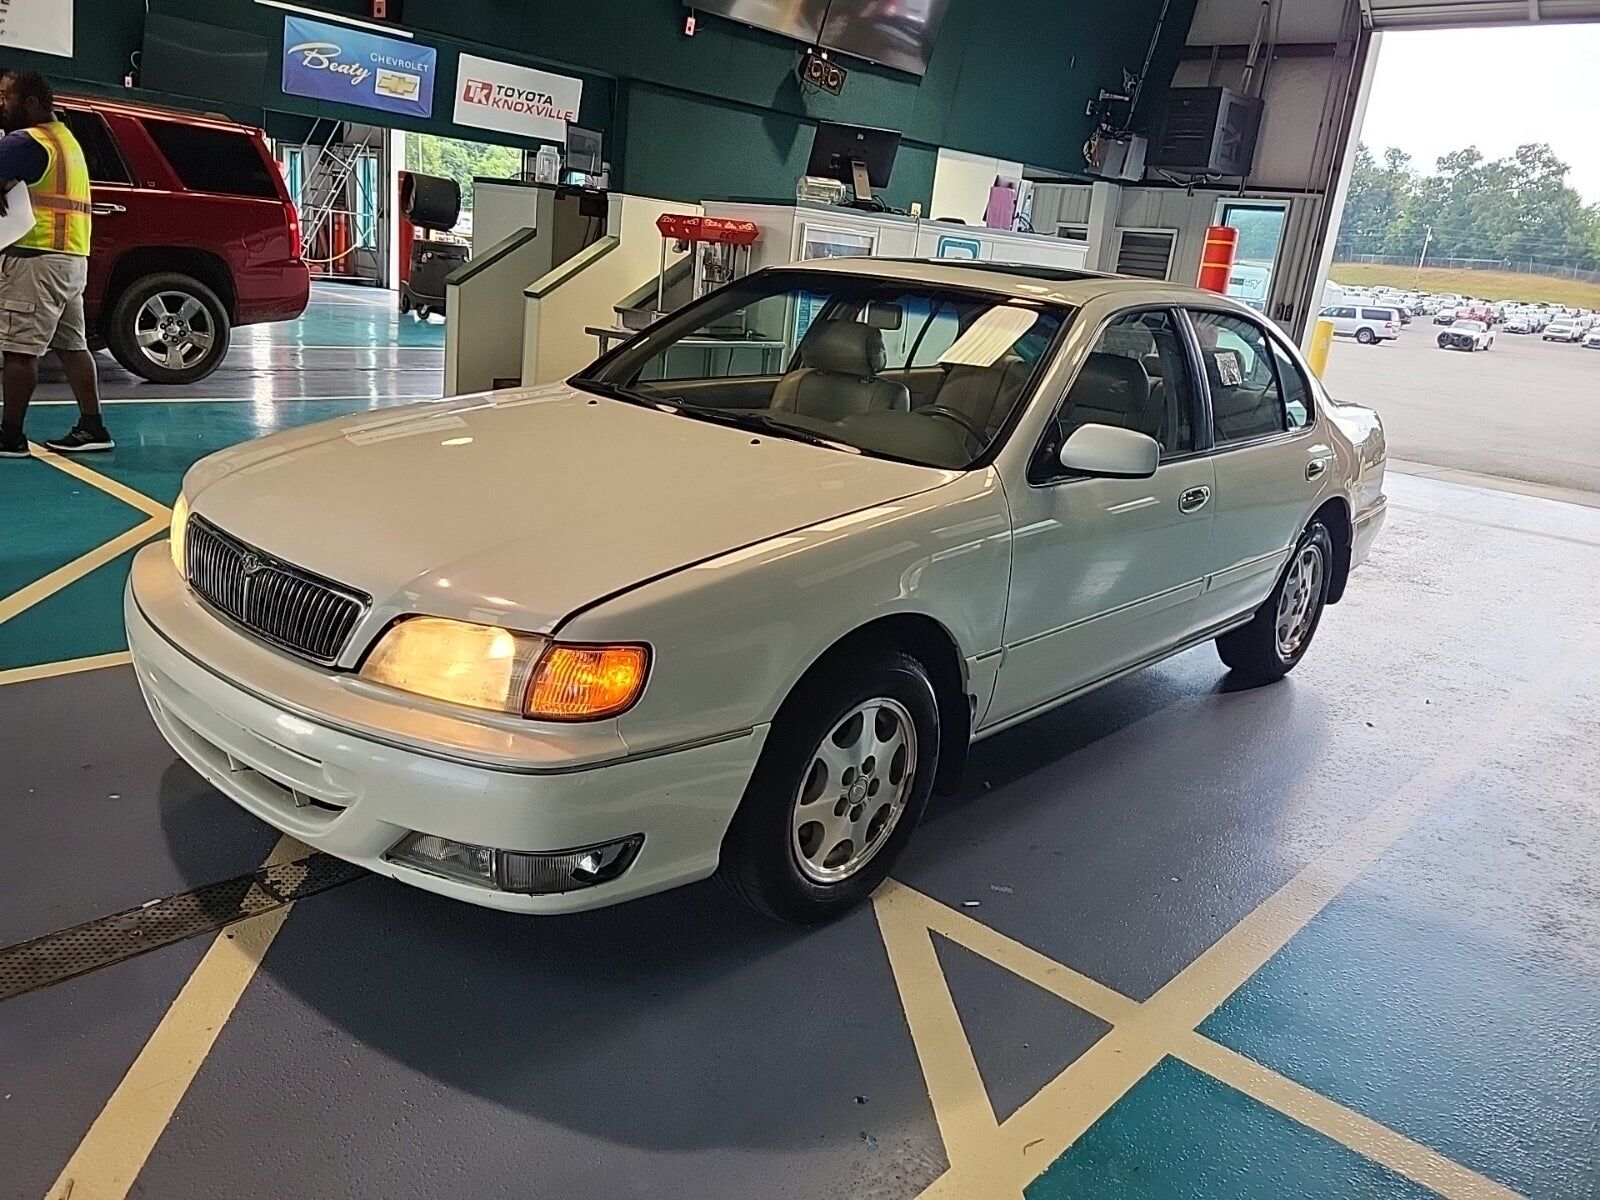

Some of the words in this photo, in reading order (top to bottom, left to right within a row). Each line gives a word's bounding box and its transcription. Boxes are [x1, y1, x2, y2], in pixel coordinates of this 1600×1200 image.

[288, 42, 371, 85] Beaty
[370, 52, 429, 73] CHEVROLET
[465, 80, 491, 105] TK
[496, 84, 553, 106] TOYOTA
[491, 97, 573, 121] KNOXVILLE
